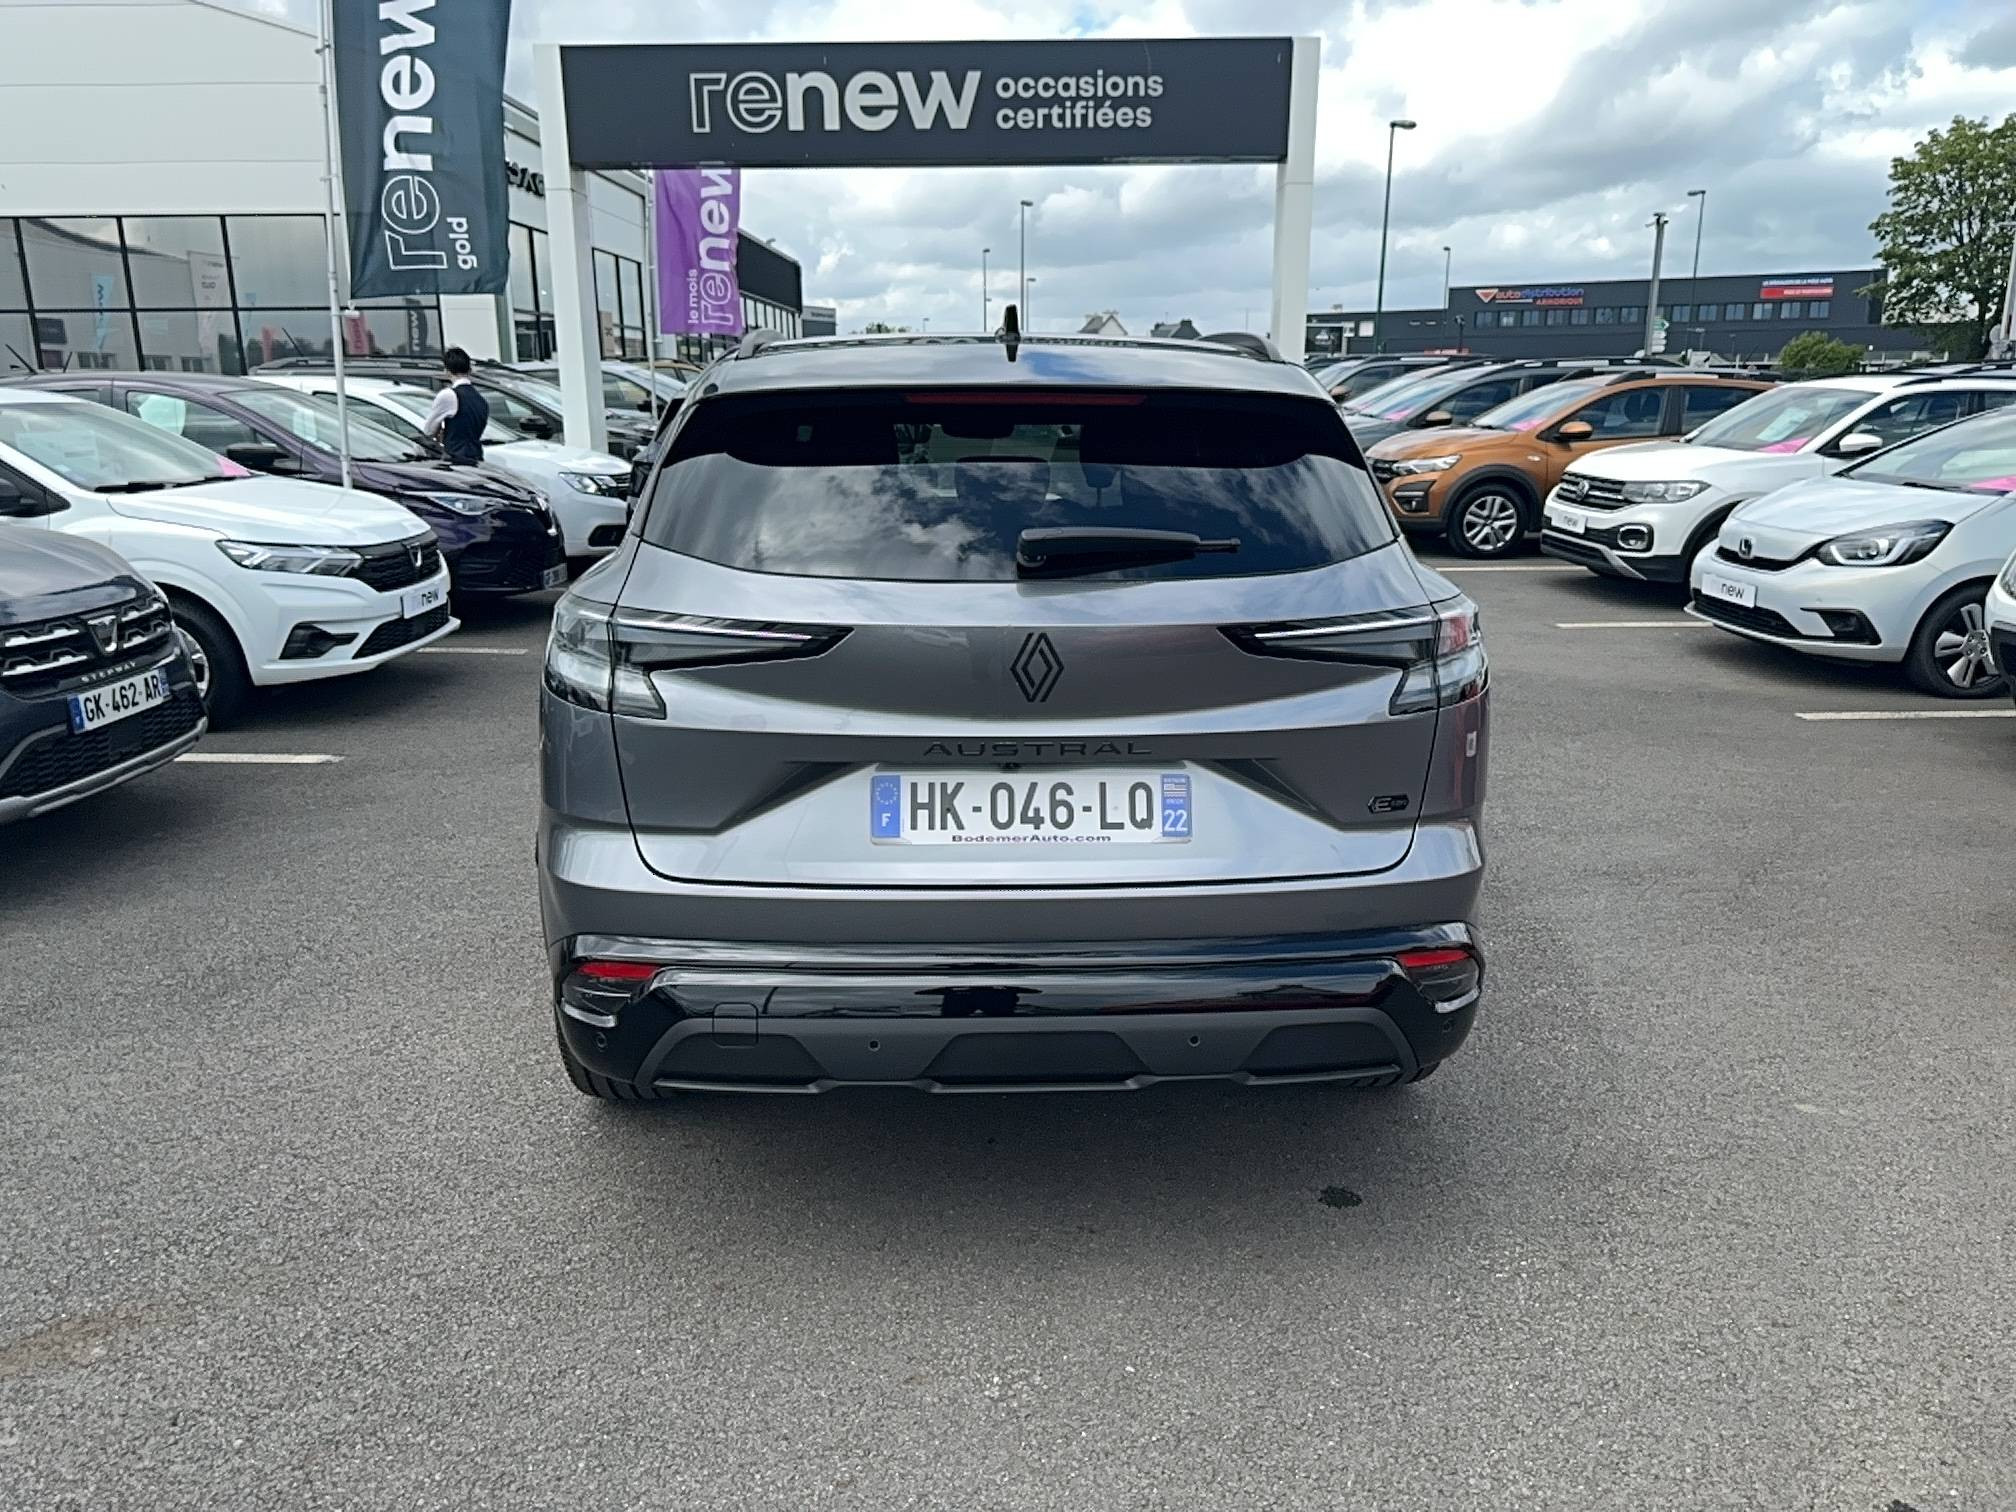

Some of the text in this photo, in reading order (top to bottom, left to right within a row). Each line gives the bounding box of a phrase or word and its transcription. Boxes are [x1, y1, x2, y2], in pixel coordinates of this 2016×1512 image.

[995, 69, 1164, 99] occasions
[689, 70, 982, 134] renew
[995, 101, 1152, 130] certifiées
[447, 217, 477, 270] gold
[687, 269, 699, 307] mois
[421, 588, 440, 607] new
[1720, 583, 1744, 599] new
[83, 674, 162, 722] GK-462-AR
[923, 741, 1153, 757] AUSTRAL
[881, 813, 890, 827] F
[910, 781, 1154, 831] HK-046-LQ
[1163, 809, 1188, 832] 22
[951, 834, 1112, 843] BodemerAuto.com
